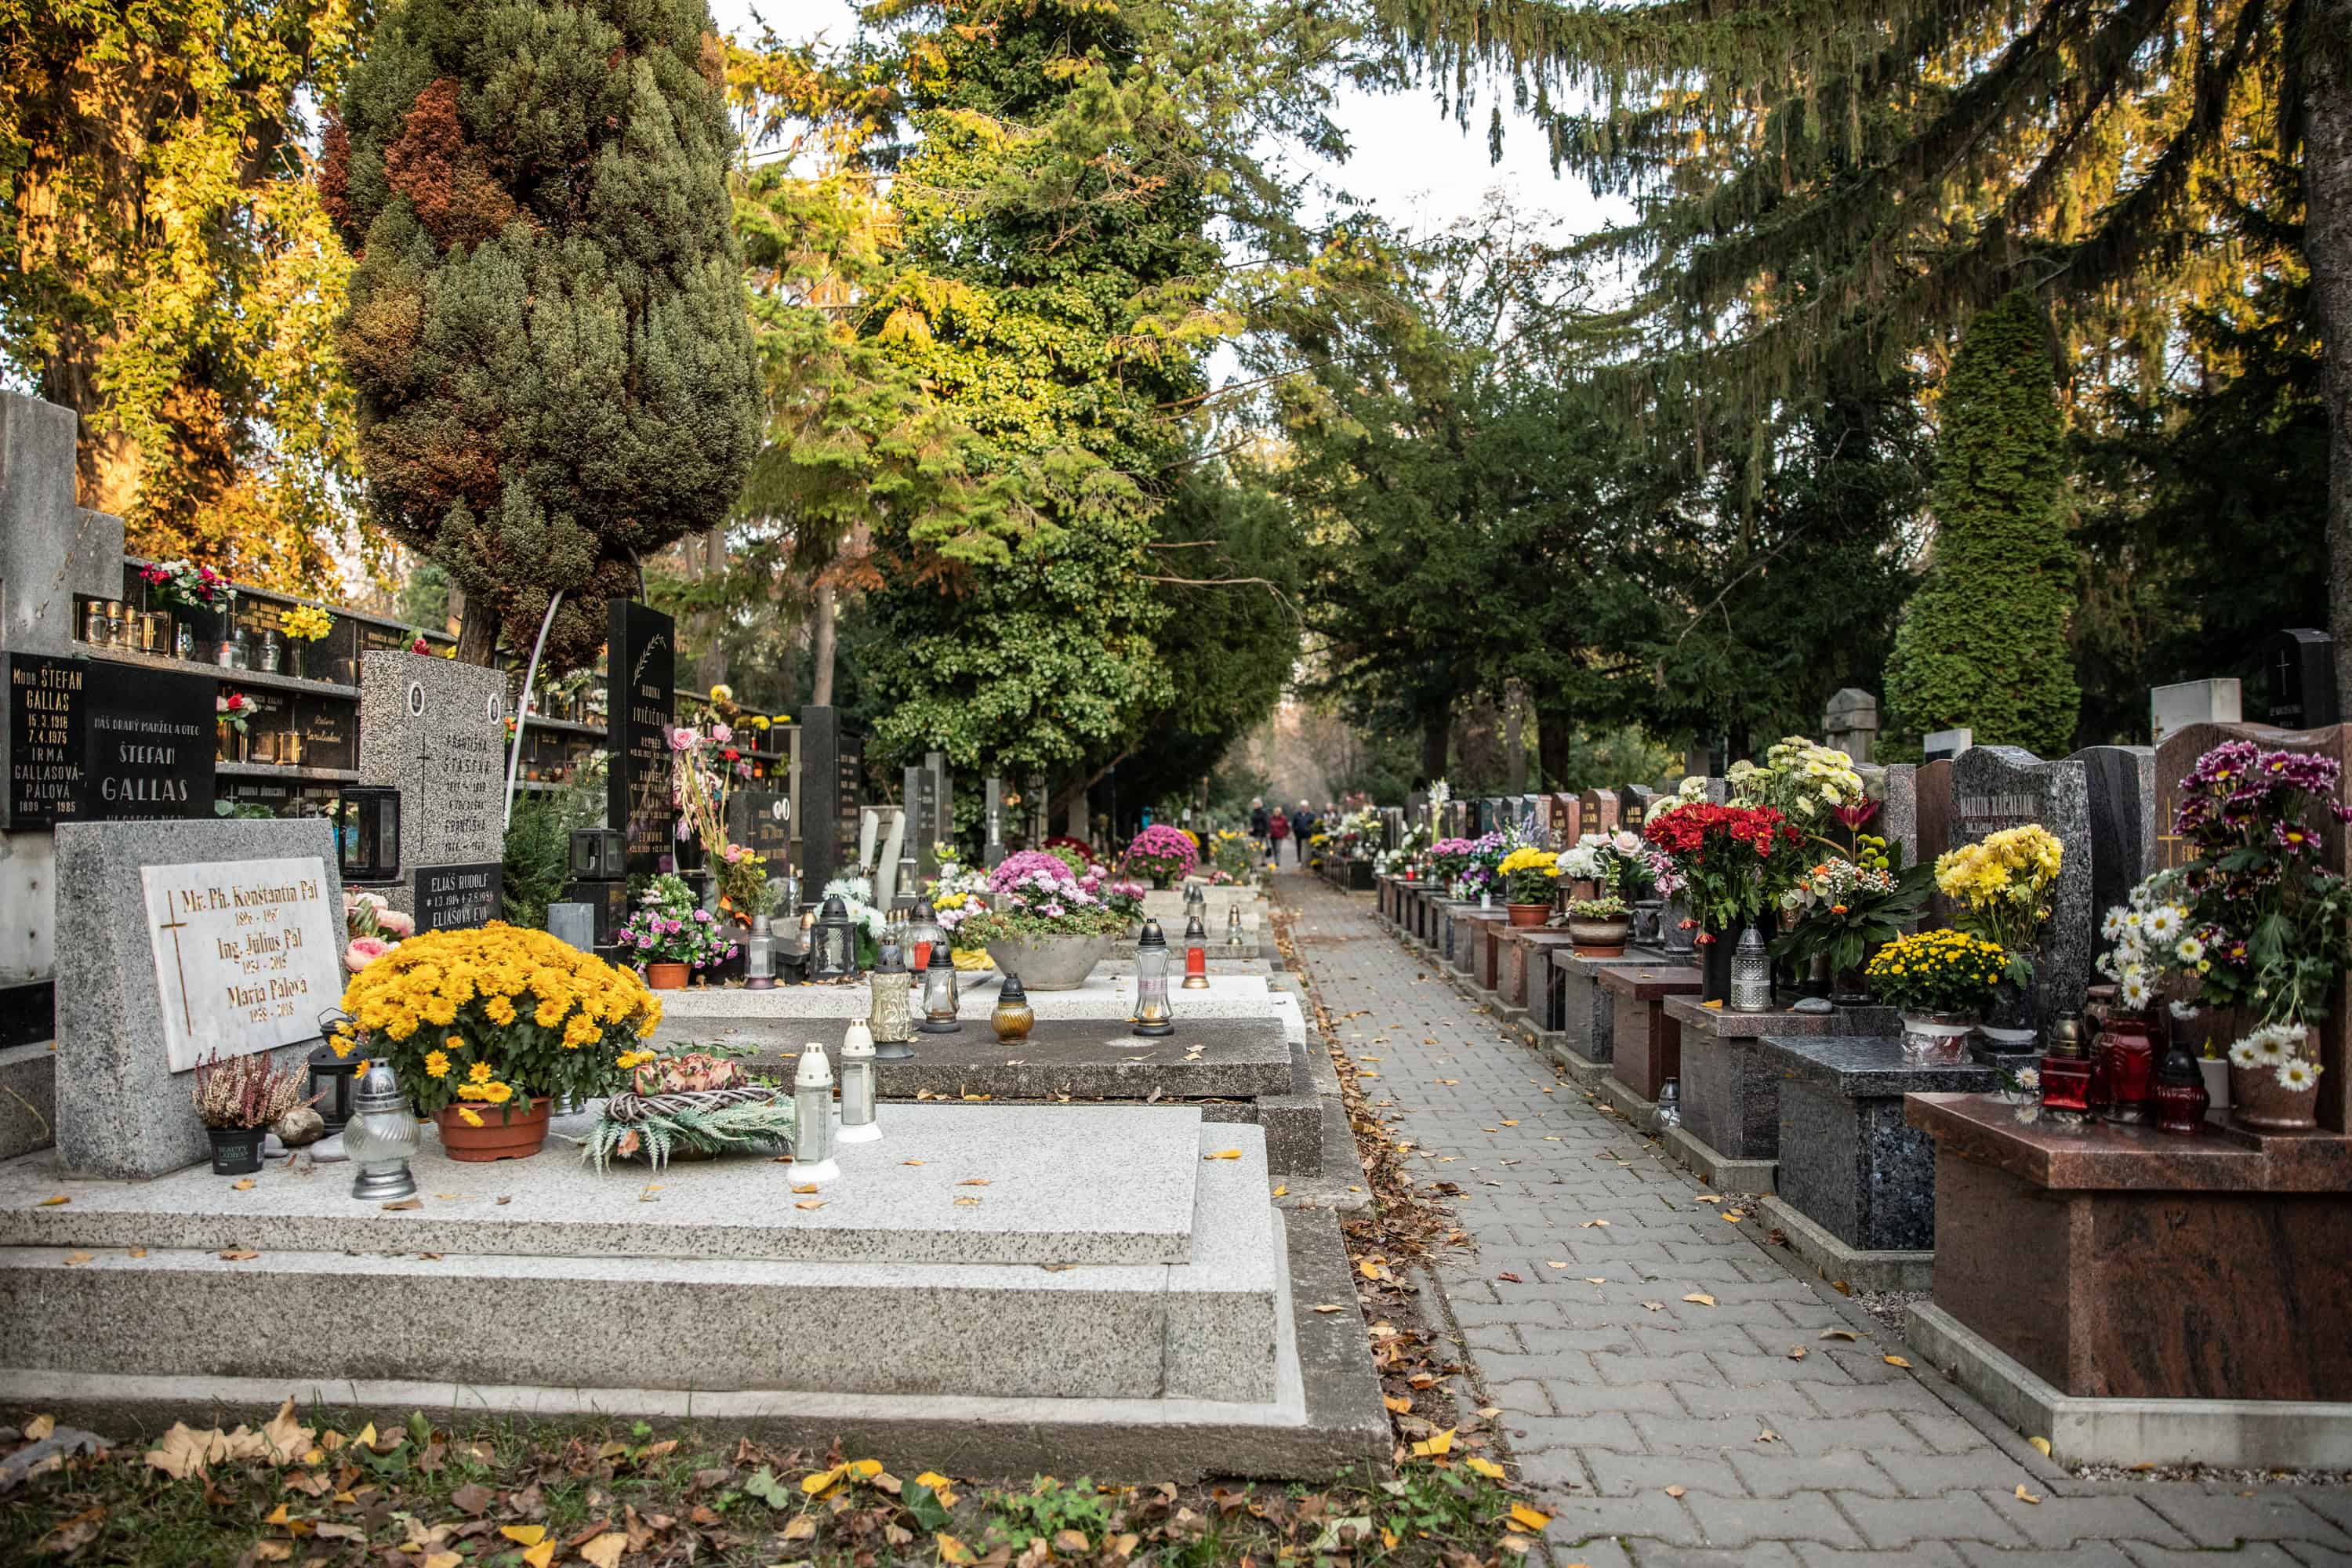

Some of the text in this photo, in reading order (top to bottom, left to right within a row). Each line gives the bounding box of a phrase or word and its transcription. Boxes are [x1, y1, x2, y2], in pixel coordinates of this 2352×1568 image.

[26, 690, 70, 712] GALLAS
[31, 747, 64, 761] IRMA
[25, 780, 71, 799] PÁLOVÁ
[101, 776, 188, 801] GALLAS
[459, 873, 489, 890] RUDOLF
[181, 889, 207, 913] Mr.
[208, 887, 230, 910] Ph.
[217, 938, 243, 964] Ing.
